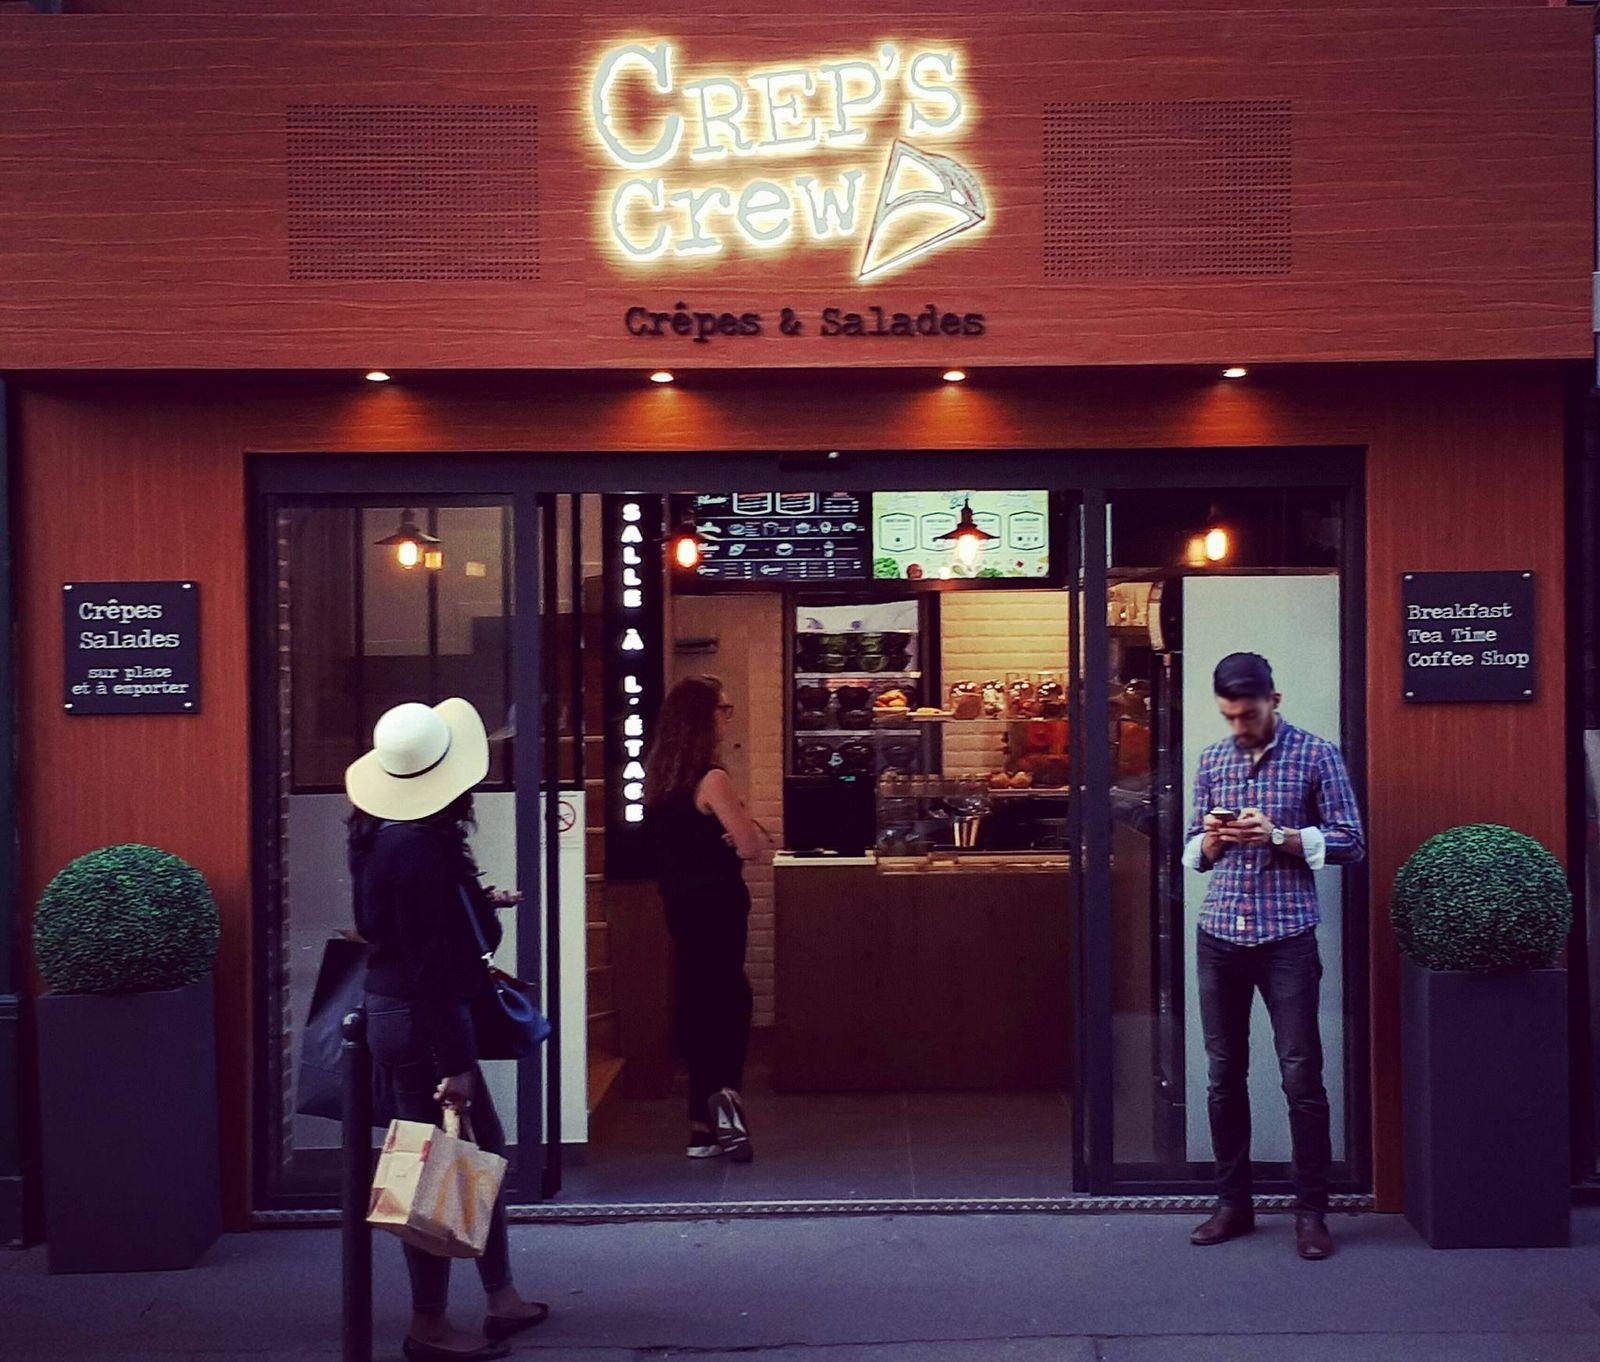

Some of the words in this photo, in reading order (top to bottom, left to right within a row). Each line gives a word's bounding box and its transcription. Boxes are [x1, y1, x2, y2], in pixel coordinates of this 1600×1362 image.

[612, 171, 863, 257] Crew
[625, 302, 762, 342] Crêpes
[780, 307, 802, 336] &
[821, 304, 985, 336] Salades
[621, 503, 643, 608] SALLE
[78, 598, 163, 624] Crêpes
[1407, 603, 1513, 620] Breakfast
[79, 629, 181, 649] Salades
[1407, 629, 1444, 644] Tea
[1451, 626, 1497, 643] Time
[1407, 651, 1474, 667] Coffee
[1480, 650, 1530, 668] Shop
[87, 668, 119, 679] sur
[123, 665, 173, 681] place
[71, 682, 92, 695] et
[95, 681, 108, 695] à
[112, 681, 190, 697] emporter
